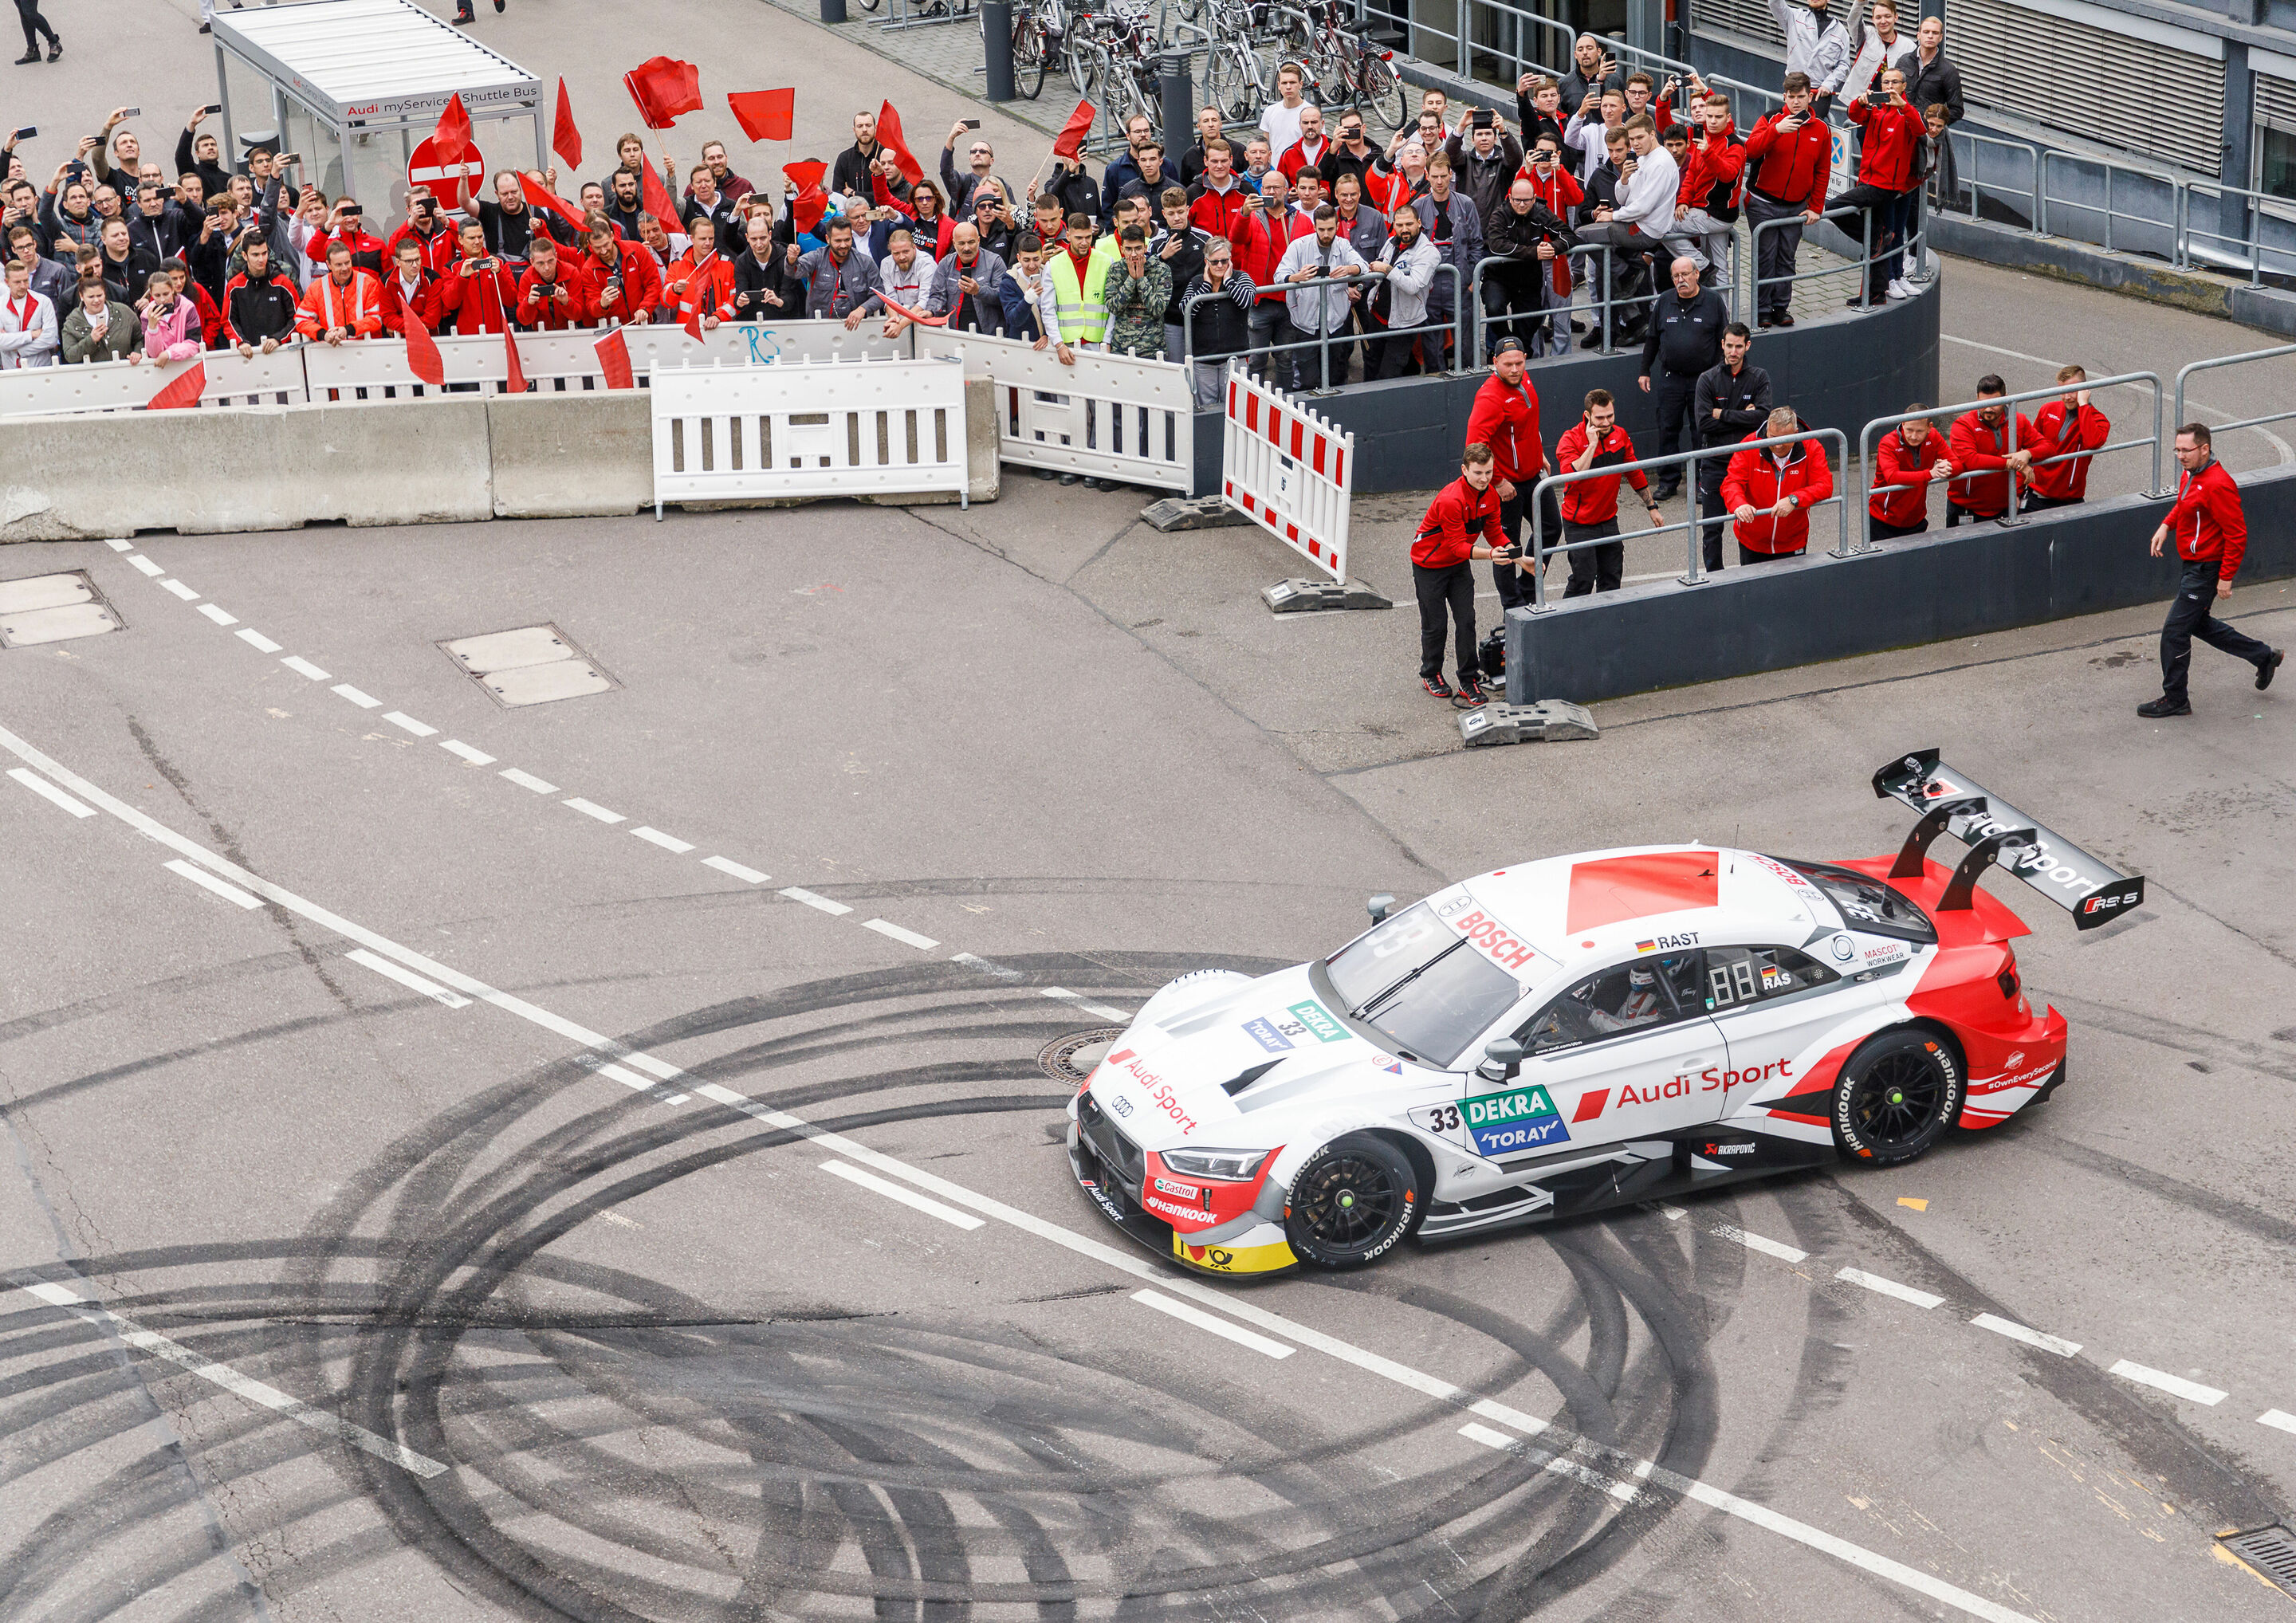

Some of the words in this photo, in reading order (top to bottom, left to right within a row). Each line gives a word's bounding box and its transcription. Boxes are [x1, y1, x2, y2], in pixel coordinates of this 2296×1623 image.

[348, 104, 379, 116] Audi
[384, 97, 450, 113] myService
[462, 90, 510, 103] Shuttle
[513, 87, 537, 97] Bus
[911, 231, 938, 244] HAMPION
[913, 237, 926, 246] 019
[738, 325, 780, 364] RS
[1747, 855, 1807, 886] BOSCH
[2091, 896, 2121, 911] RS
[2122, 892, 2138, 905] 5
[1455, 910, 1535, 970] BOSCH
[1657, 932, 1700, 949] RAST
[1866, 952, 1905, 967] WORKWEAR
[1762, 973, 1792, 990] RAS
[1278, 1021, 1307, 1036] 33
[1295, 1005, 1340, 1039] DEKRA
[1616, 1075, 1691, 1109] Audi
[1701, 1058, 1793, 1093] Sport
[1987, 1058, 2058, 1091] #OwnEverySecond
[1123, 1059, 1163, 1090] Audi
[1153, 1085, 1197, 1135] Sport
[1429, 1106, 1461, 1133] 33
[1468, 1091, 1547, 1124] DEKRA
[1088, 1186, 1105, 1204] Audi
[1101, 1200, 1124, 1222] Sport
[1164, 1181, 1195, 1198] Castrol
